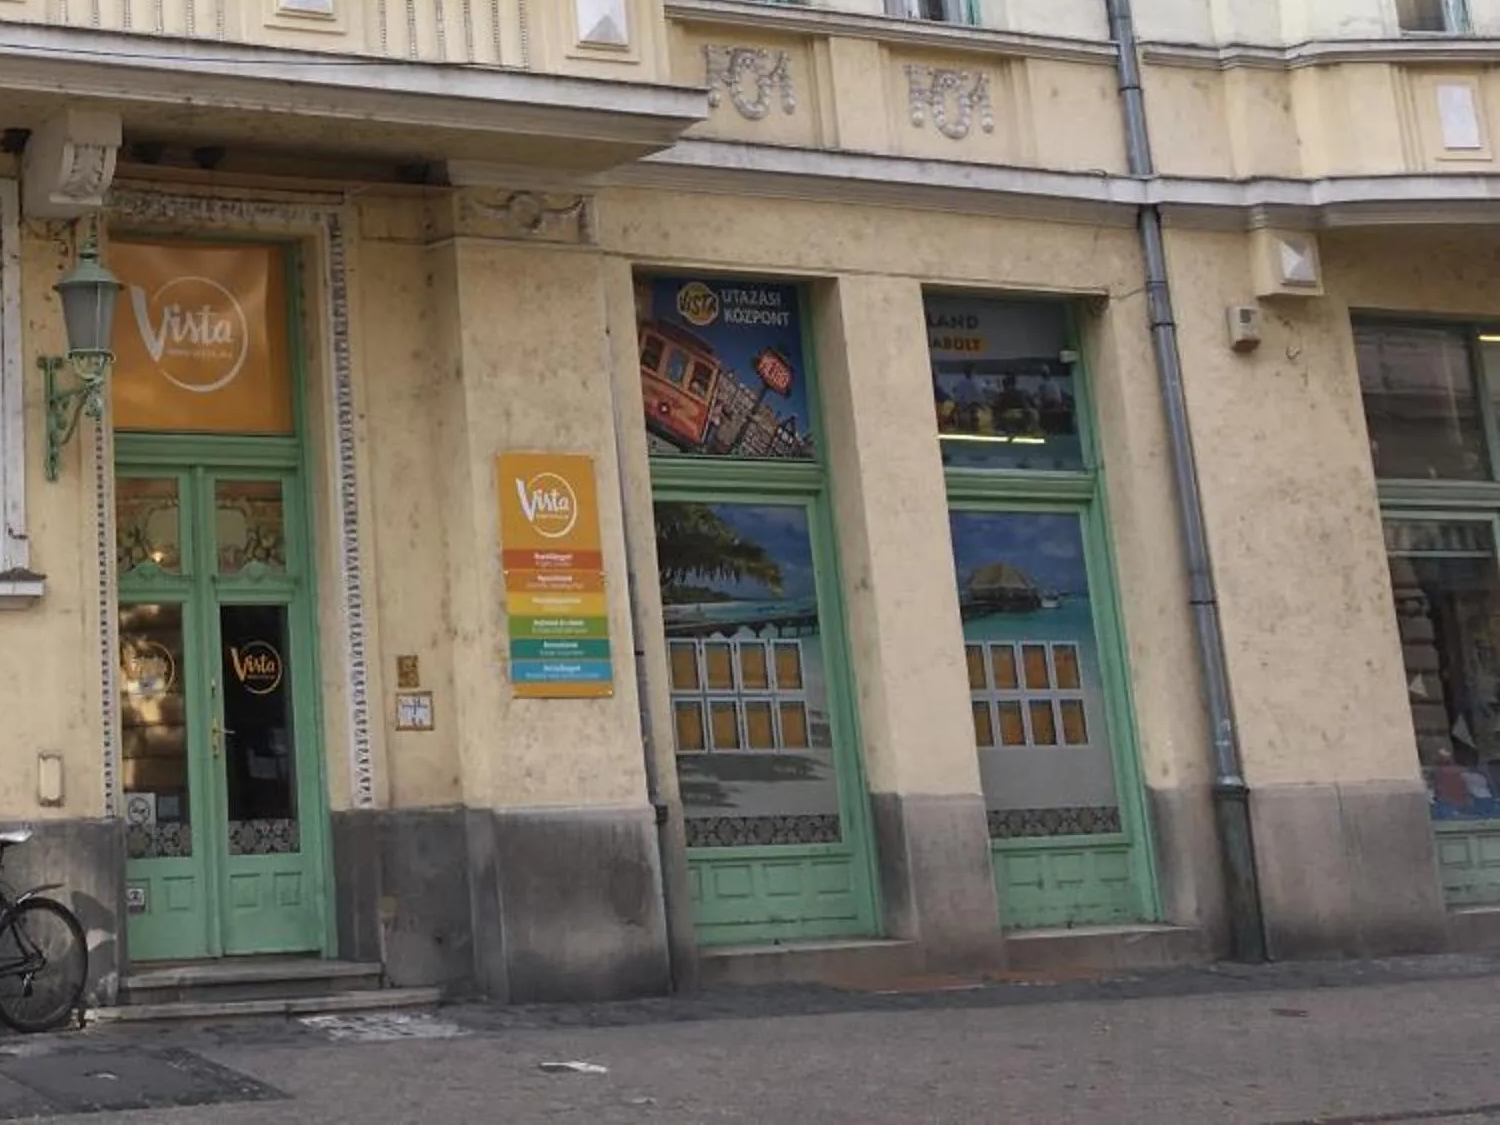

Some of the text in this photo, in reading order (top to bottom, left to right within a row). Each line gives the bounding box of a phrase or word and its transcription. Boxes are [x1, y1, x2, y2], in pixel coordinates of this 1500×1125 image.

[129, 285, 234, 362] Vista
[515, 477, 570, 523] Vista
[230, 647, 276, 682] Vista
